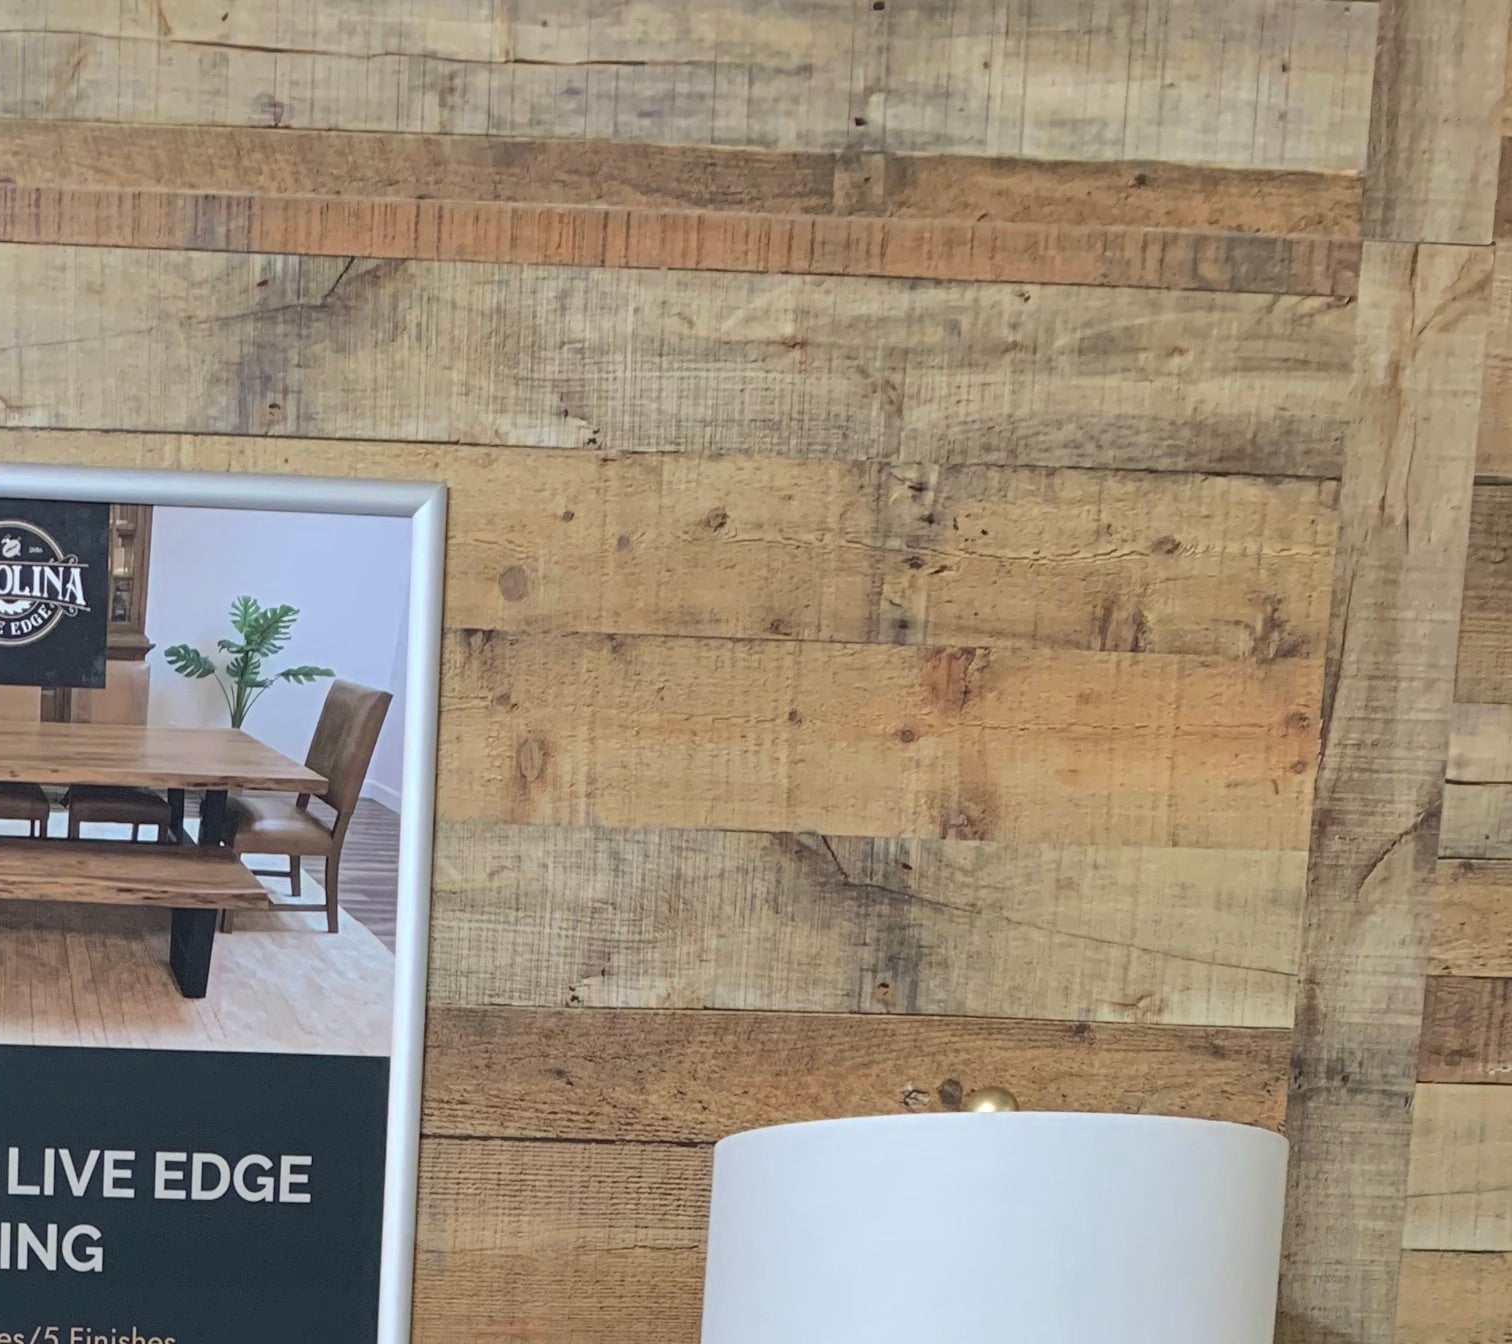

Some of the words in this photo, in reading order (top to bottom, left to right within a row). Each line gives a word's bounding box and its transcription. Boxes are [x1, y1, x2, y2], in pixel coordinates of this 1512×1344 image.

[10, 604, 52, 635] EDGE
[6, 1146, 136, 1199] LIVE
[153, 1151, 314, 1204] EDGE
